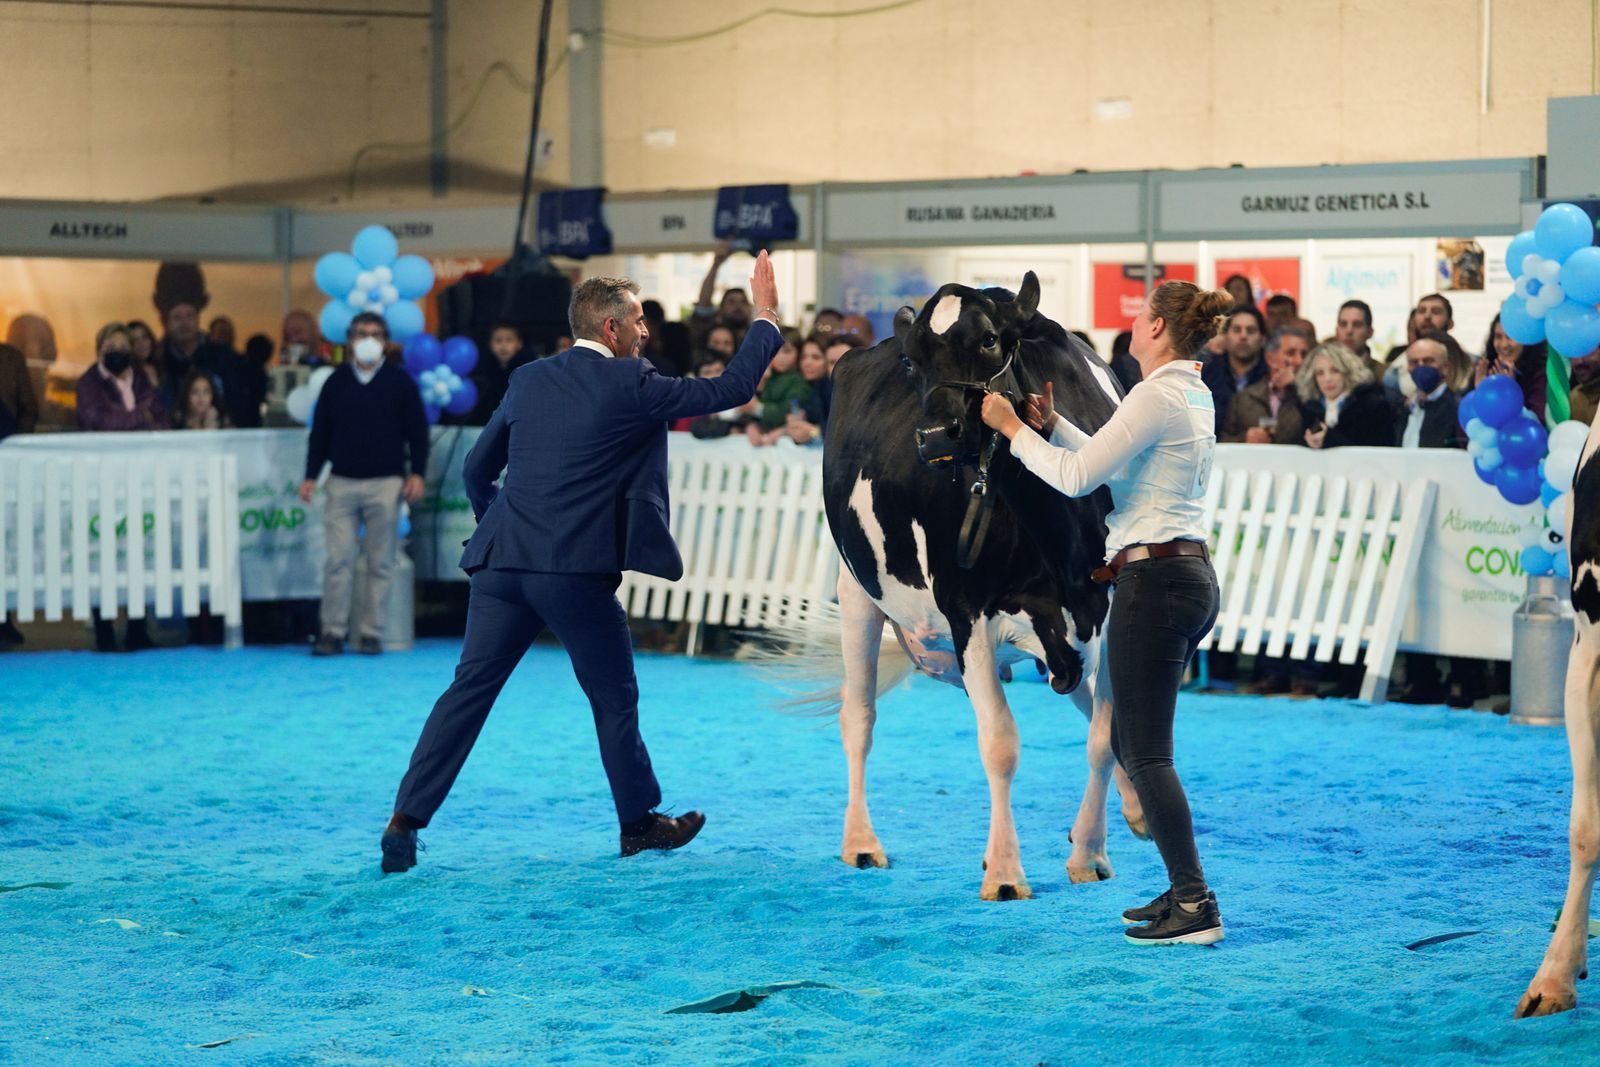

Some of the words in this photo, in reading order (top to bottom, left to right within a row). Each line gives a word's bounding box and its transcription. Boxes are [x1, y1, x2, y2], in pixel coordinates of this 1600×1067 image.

[1241, 196, 1310, 213] GARMUZ
[1315, 193, 1399, 212] GENETICA
[1405, 190, 1430, 209] S.L
[660, 214, 686, 231] BPA
[971, 204, 1055, 222] GANADERIA
[49, 221, 128, 239] ALLTECH
[239, 507, 306, 533] OVAP
[1465, 546, 1525, 577] COV
